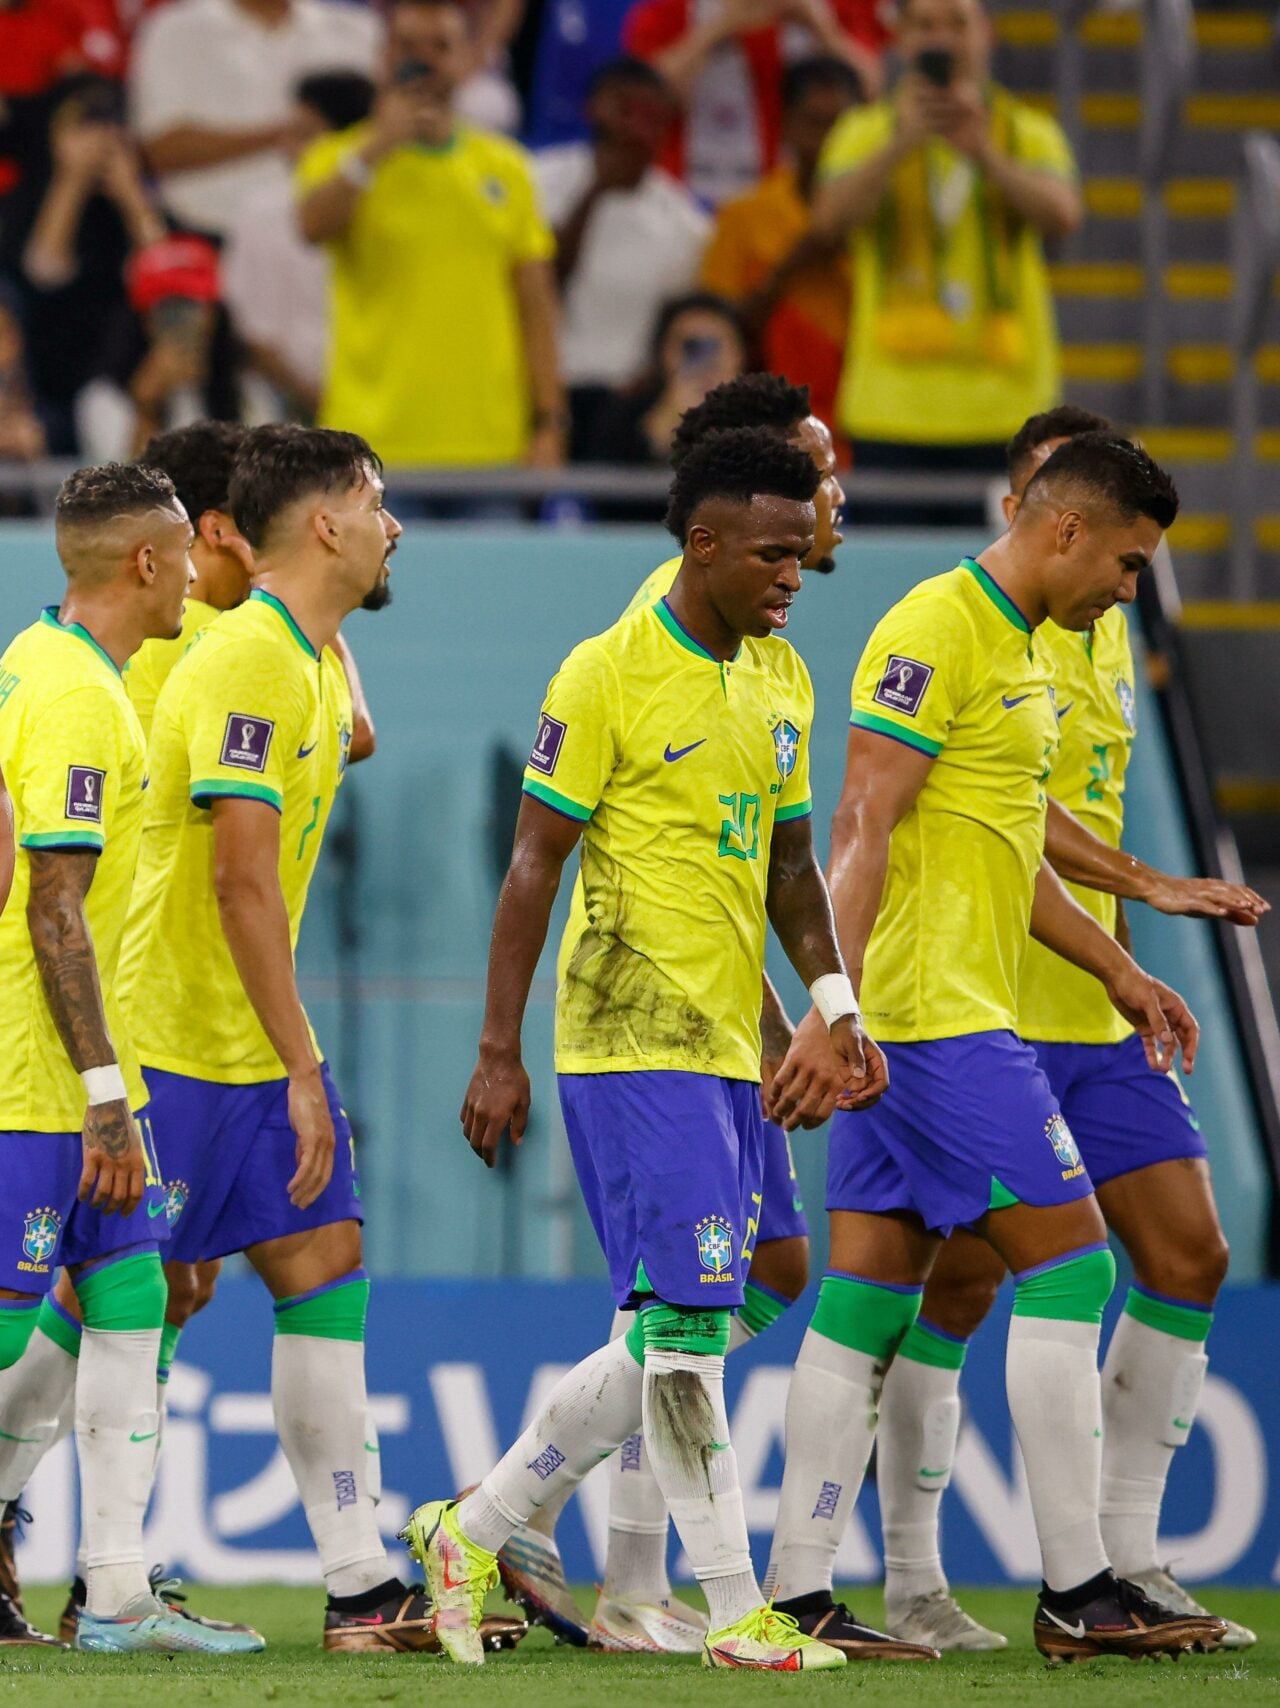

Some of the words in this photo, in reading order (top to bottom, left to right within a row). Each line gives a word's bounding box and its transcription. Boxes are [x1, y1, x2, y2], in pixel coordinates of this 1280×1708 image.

[718, 792, 761, 861] 20
[708, 1242, 721, 1250] CBF
[17, 1260, 50, 1274] BRASIL
[699, 1272, 735, 1284] BRASIL
[426, 1362, 1280, 1584] WAND
[526, 1443, 566, 1481] BRASIL
[332, 1470, 358, 1512] BRASIL
[812, 1481, 842, 1520] BRASIL
